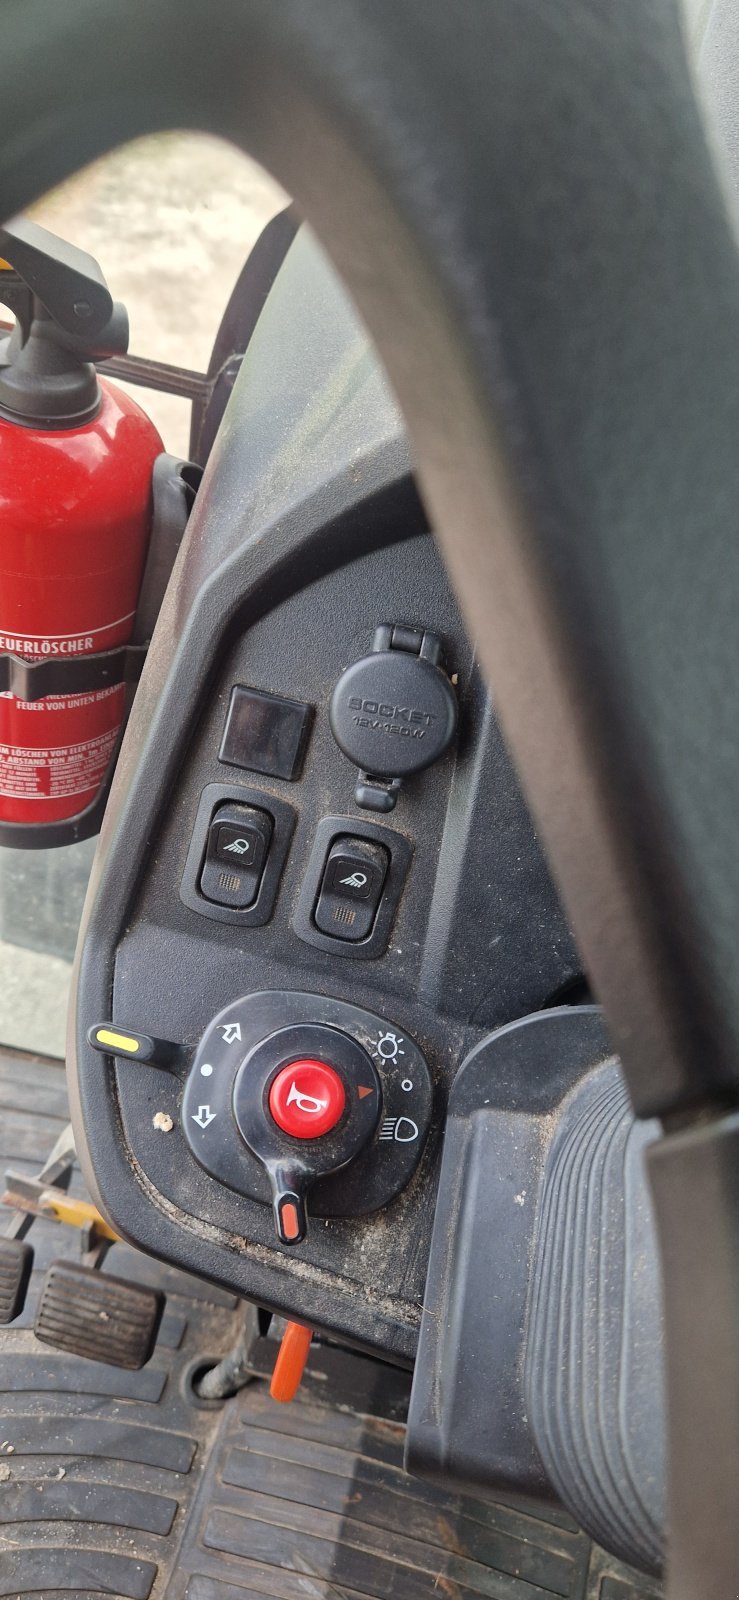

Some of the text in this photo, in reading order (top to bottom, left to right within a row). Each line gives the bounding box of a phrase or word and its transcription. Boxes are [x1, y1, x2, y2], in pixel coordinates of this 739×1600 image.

[16, 701, 44, 711] FEUER
[46, 702, 65, 711] VON
[67, 695, 95, 709] UNTEN
[348, 695, 437, 726] SOCKET
[11, 748, 48, 758] LÖSCHEN
[50, 749, 67, 758] VON
[7, 756, 46, 766] ABSTAND
[47, 757, 65, 765] VON
